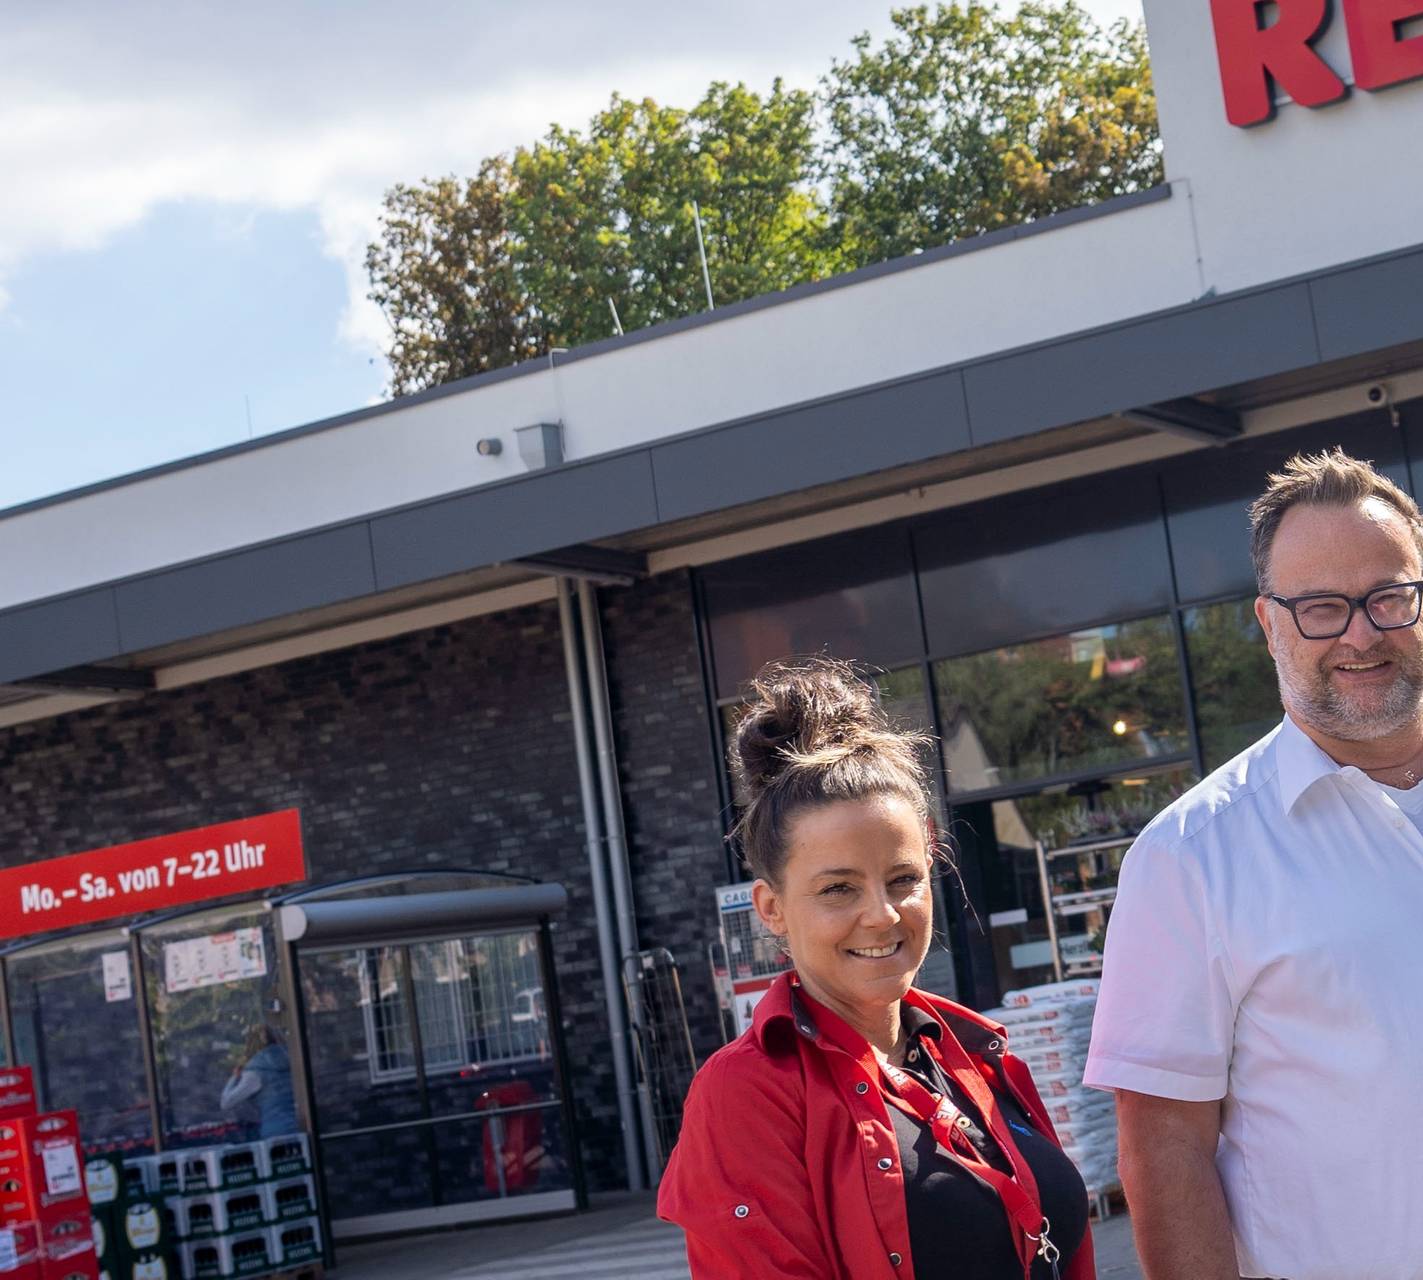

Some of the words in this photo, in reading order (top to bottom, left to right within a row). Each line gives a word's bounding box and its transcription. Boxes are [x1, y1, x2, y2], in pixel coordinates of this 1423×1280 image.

[79, 872, 115, 902] Sa.
[118, 866, 160, 893] von
[224, 840, 266, 872] Uhr
[725, 890, 752, 904] CAG
